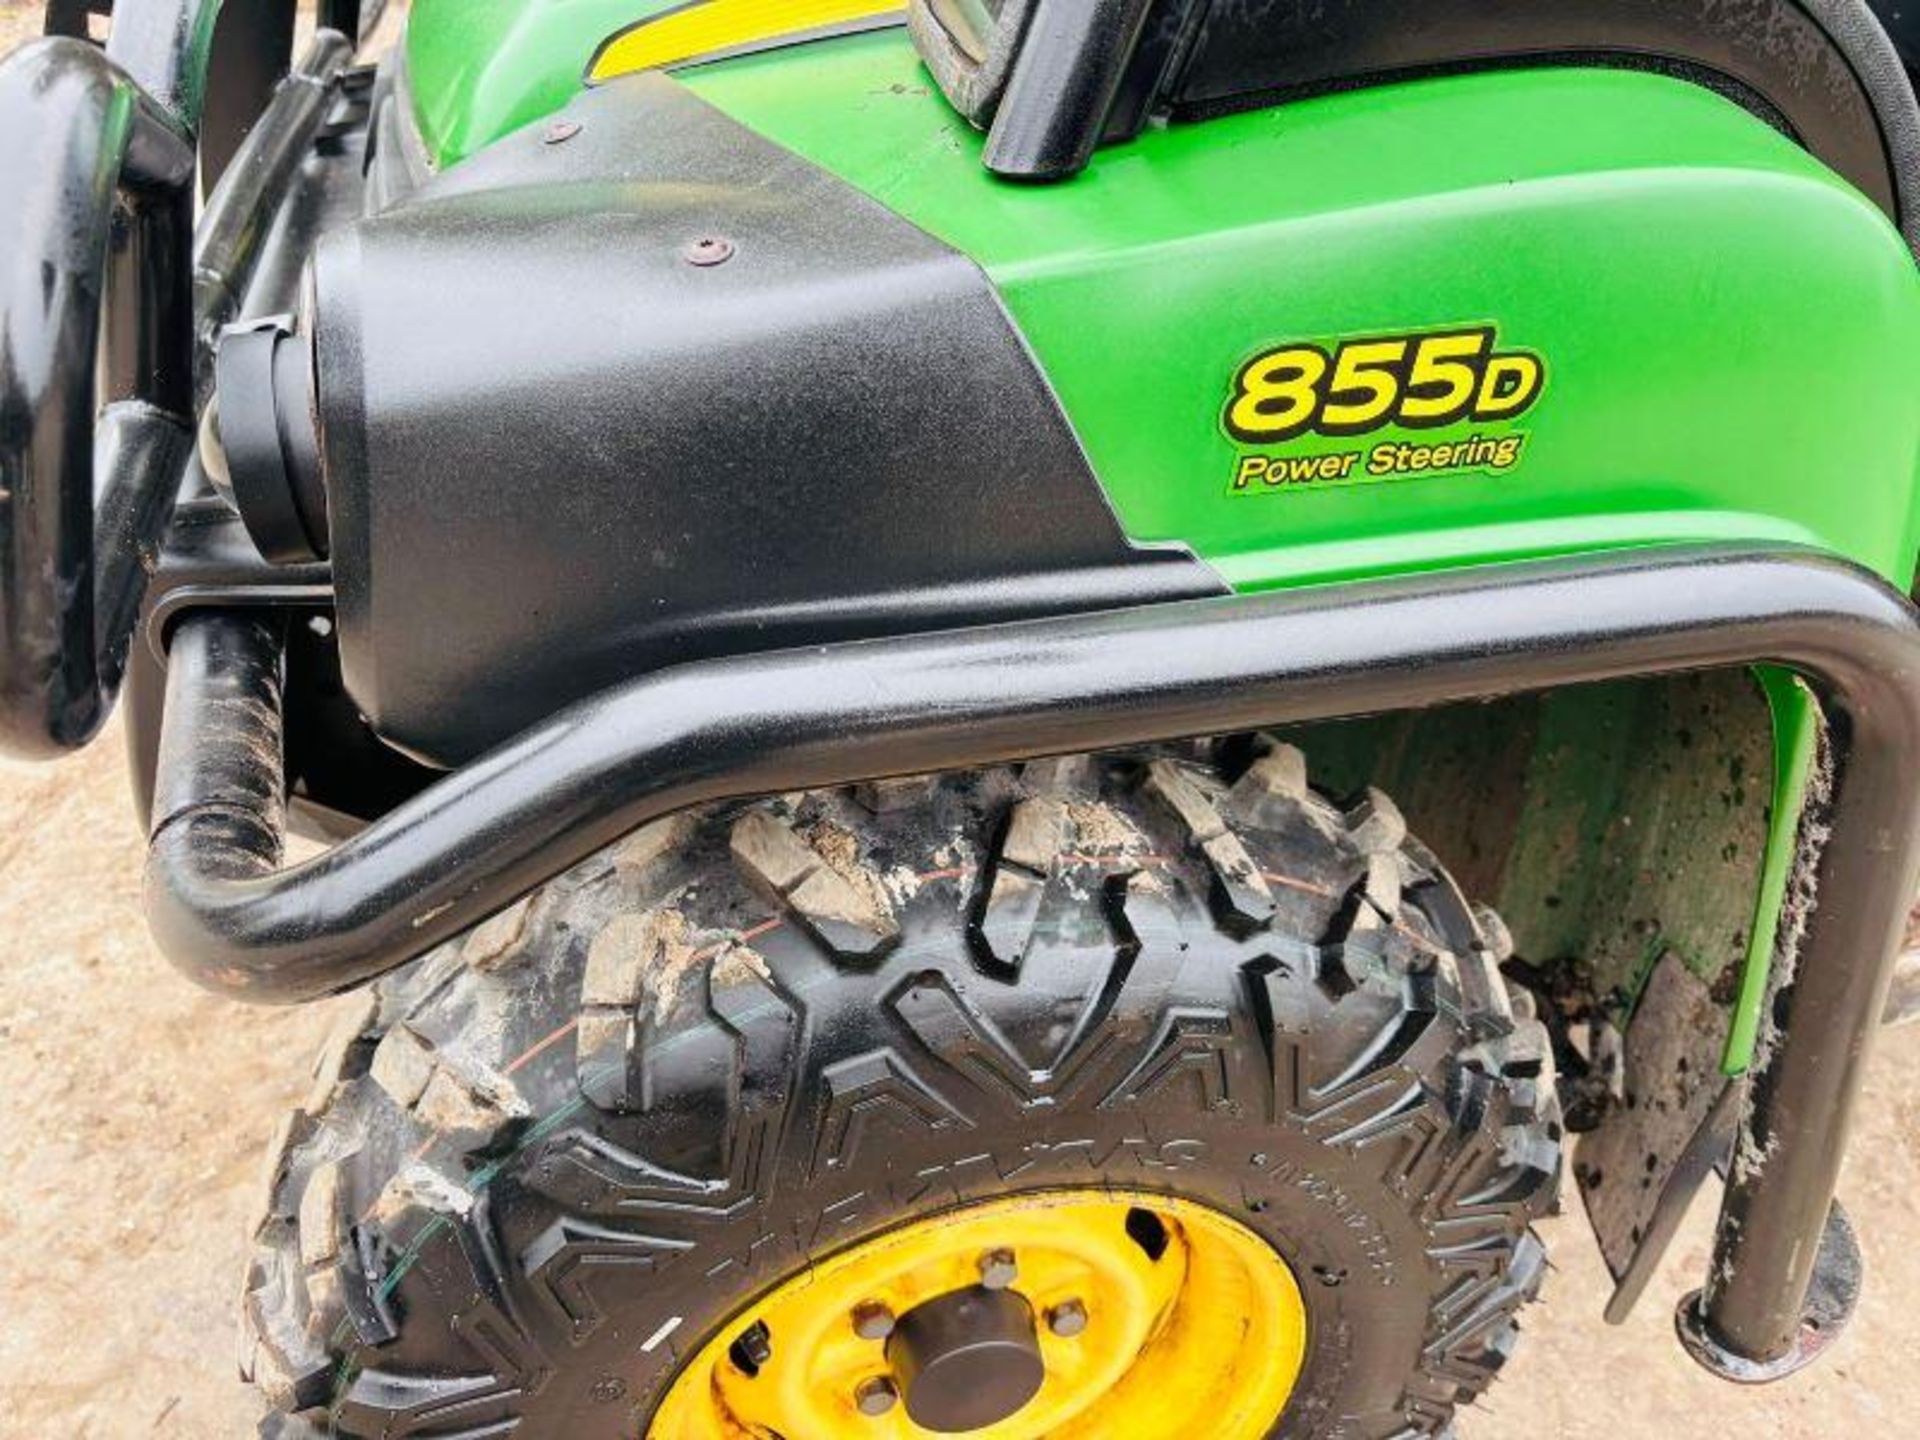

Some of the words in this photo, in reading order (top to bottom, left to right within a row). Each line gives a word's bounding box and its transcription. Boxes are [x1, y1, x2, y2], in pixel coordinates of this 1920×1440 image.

[1226, 329, 1541, 441] 855D
[1235, 453, 1360, 488] Power
[1368, 435, 1522, 474] Steering
